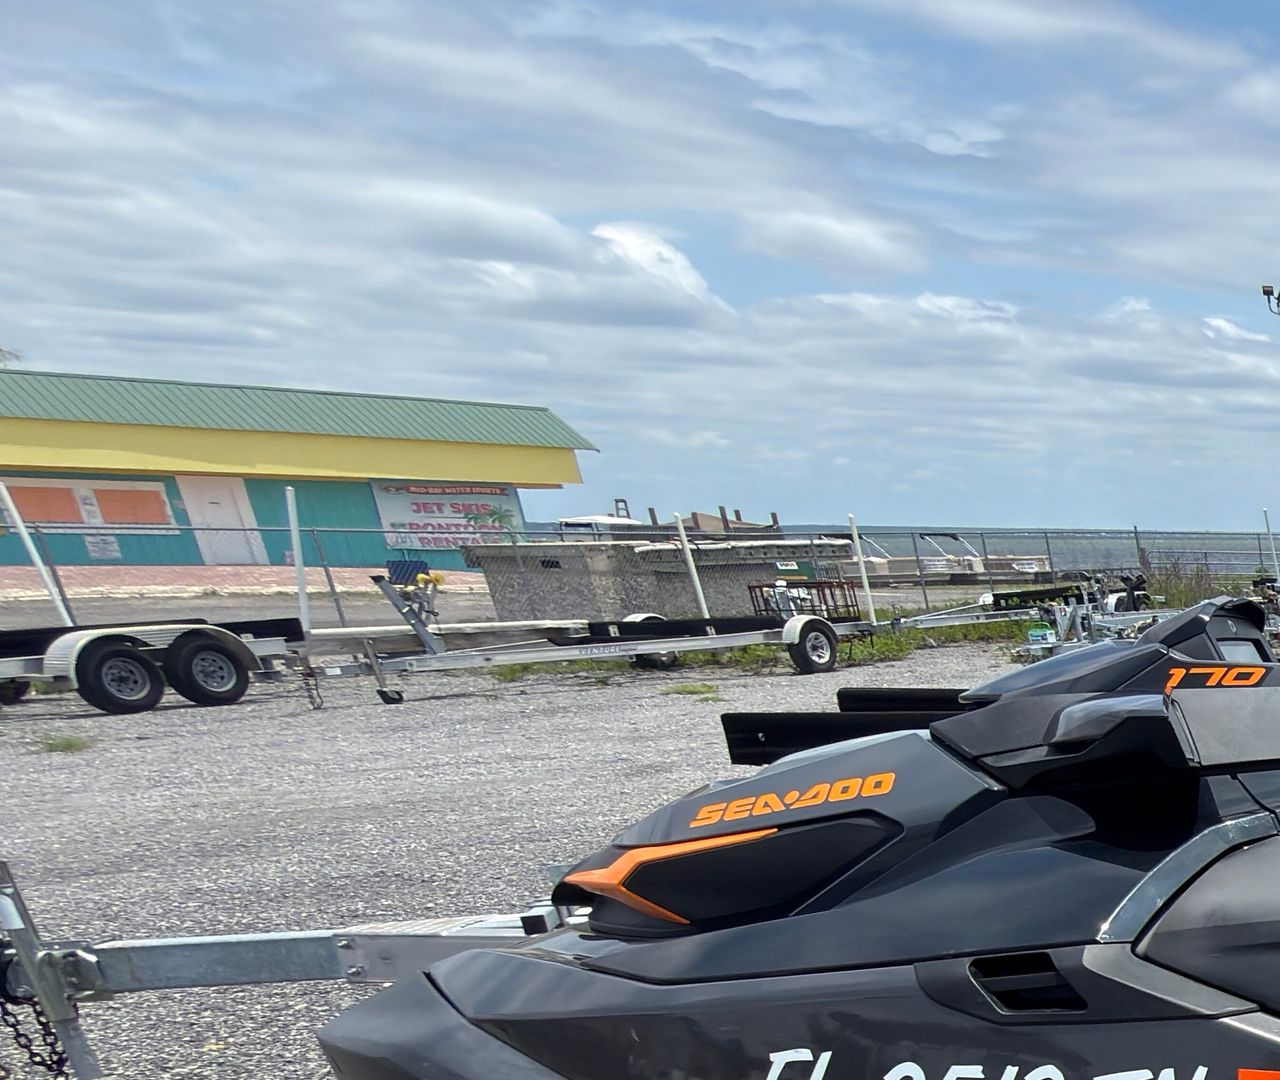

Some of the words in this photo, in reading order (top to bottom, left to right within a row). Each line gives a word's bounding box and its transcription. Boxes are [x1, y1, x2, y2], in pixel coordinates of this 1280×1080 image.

[411, 502, 444, 514] JET
[451, 502, 492, 515] SKIS
[1164, 667, 1266, 696] 170
